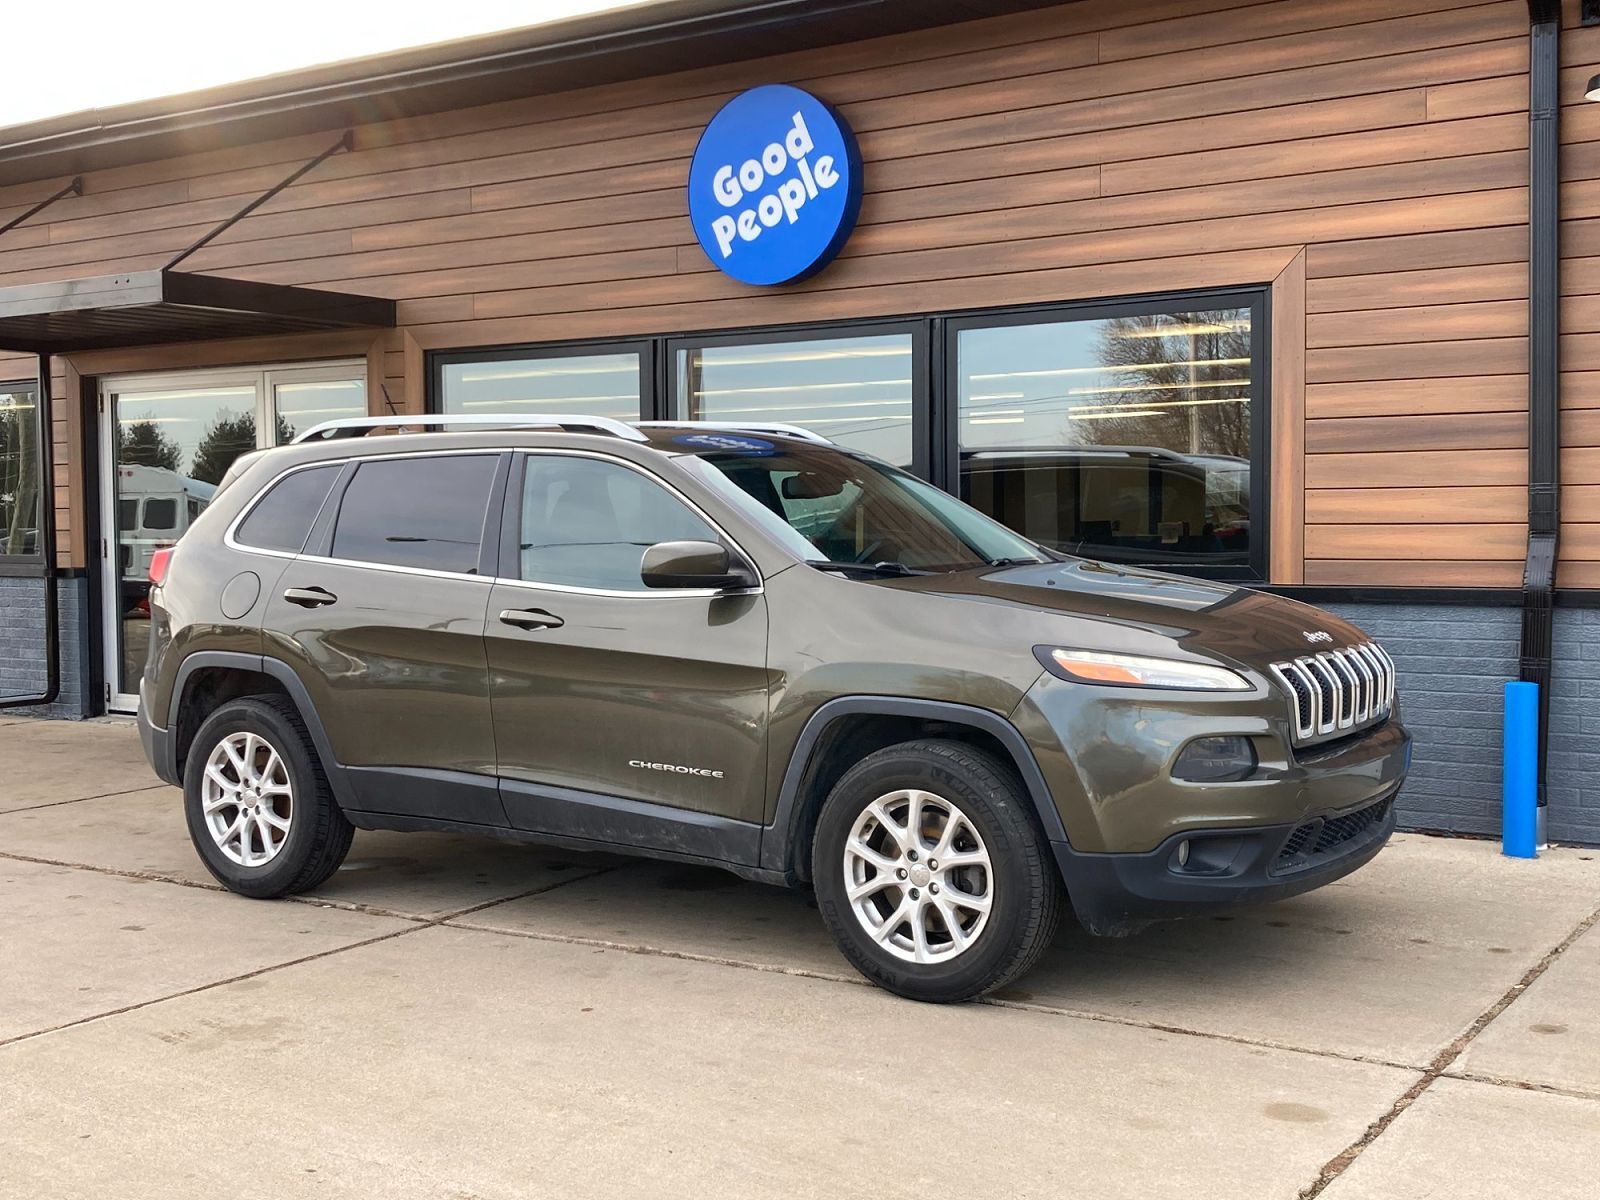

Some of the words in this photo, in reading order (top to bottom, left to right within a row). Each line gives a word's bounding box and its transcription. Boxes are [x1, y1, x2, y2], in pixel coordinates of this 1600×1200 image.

[712, 155, 840, 258] People
[713, 111, 814, 207] Good
[628, 760, 724, 778] CHEROKEE
